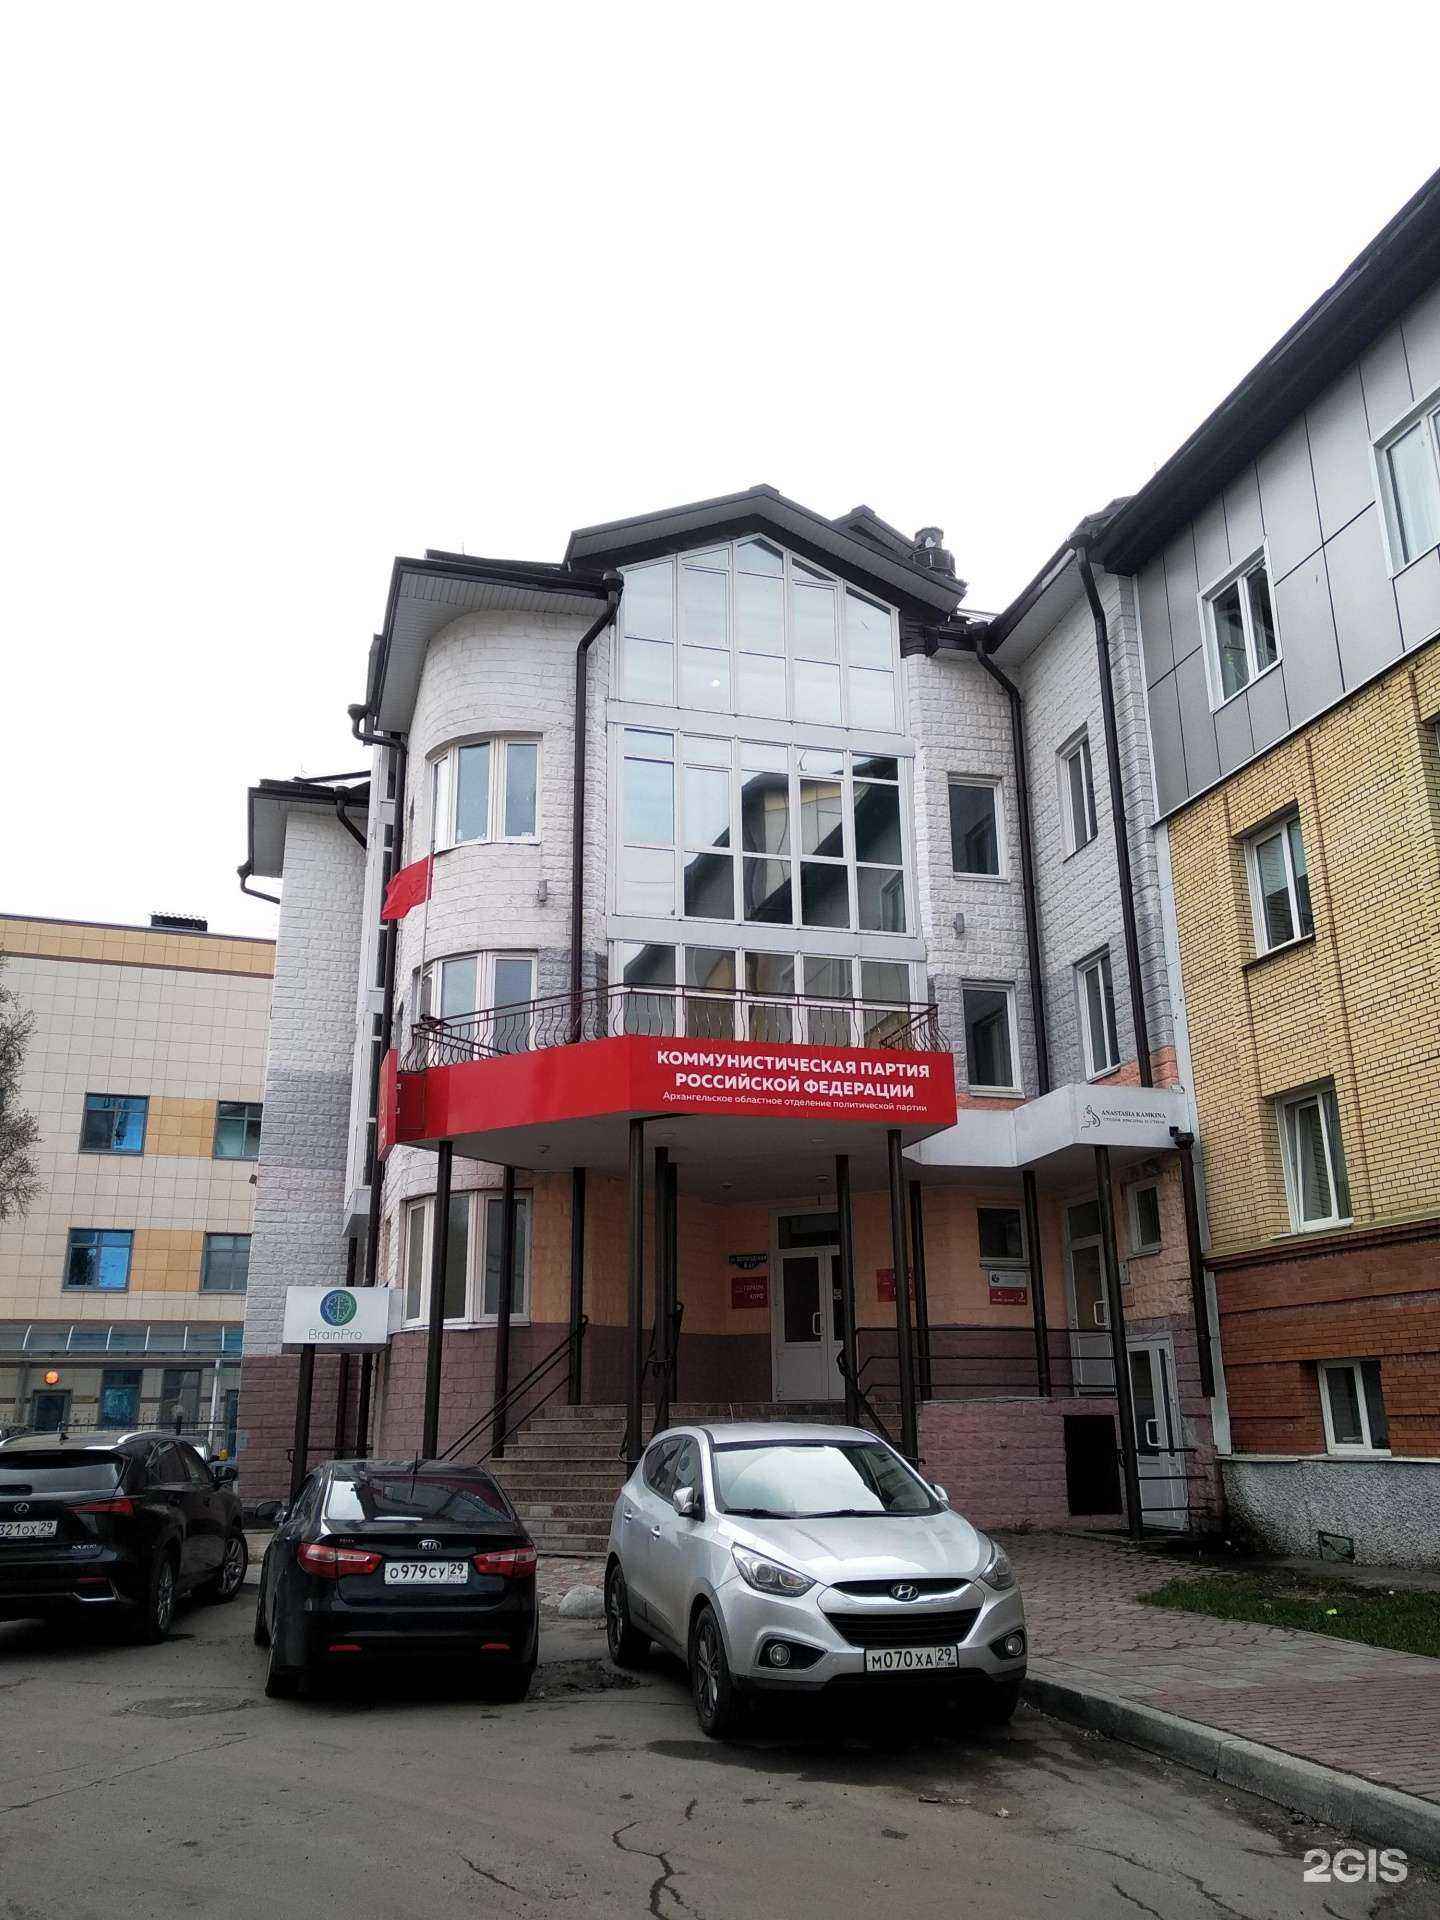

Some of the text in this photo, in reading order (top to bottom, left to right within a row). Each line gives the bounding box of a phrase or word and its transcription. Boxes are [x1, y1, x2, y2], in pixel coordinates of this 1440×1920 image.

[657, 1050, 930, 1078] КОММУНИСТИЧЕСКАЯ ПАРТИЯ
[675, 1072, 914, 1099] РОССИЙСКОЙ ФЕДЕРАЦИИ
[662, 1091, 928, 1113] Архангельское областное отделение политической партии
[1101, 1109, 1167, 1119] ANASTASIA KAMKINA
[308, 1328, 362, 1340] BrainPro
[421, 1542, 438, 1550] KIA
[450, 1563, 464, 1575] 29
[937, 1648, 952, 1661] 29
